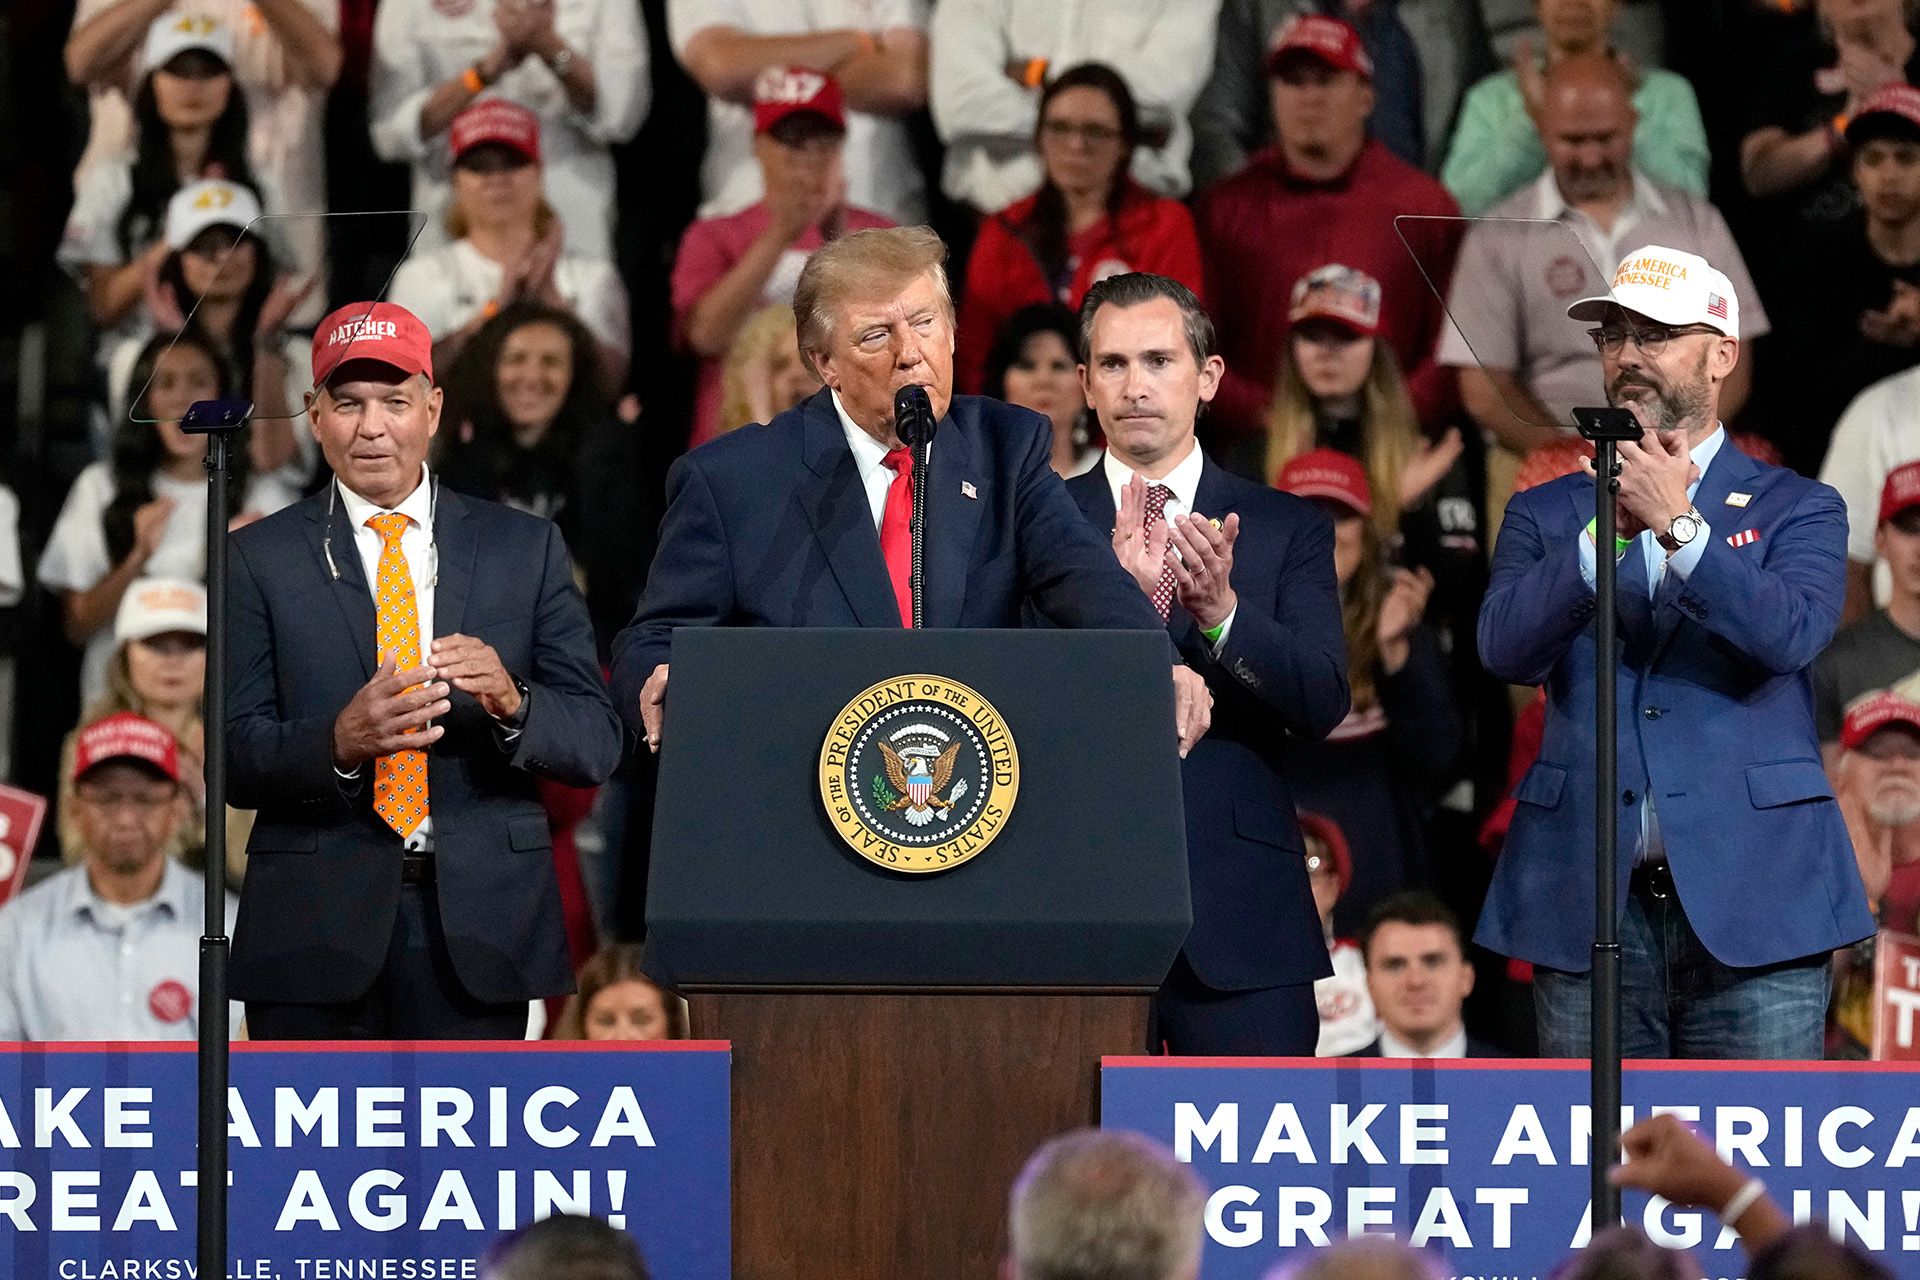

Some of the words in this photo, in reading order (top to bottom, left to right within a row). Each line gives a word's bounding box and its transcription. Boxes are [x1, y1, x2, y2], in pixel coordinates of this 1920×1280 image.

[1611, 271, 1672, 291] ENNESSEE
[1632, 258, 1688, 281] AMERICA
[328, 320, 397, 346] HATCHER
[921, 684, 941, 696] OF
[944, 688, 969, 708] THE
[827, 681, 916, 768] PRESIDENT
[972, 705, 1013, 787] UNITED
[829, 775, 842, 803] THE
[836, 806, 851, 823] OF
[850, 821, 900, 863] SEAL
[936, 804, 1003, 863] STATES
[1174, 1102, 1449, 1165] MAKE
[274, 1168, 627, 1232] AGAIN!
[1203, 1184, 1529, 1248] GREAT
[295, 1258, 477, 1280] TENNESSEE
